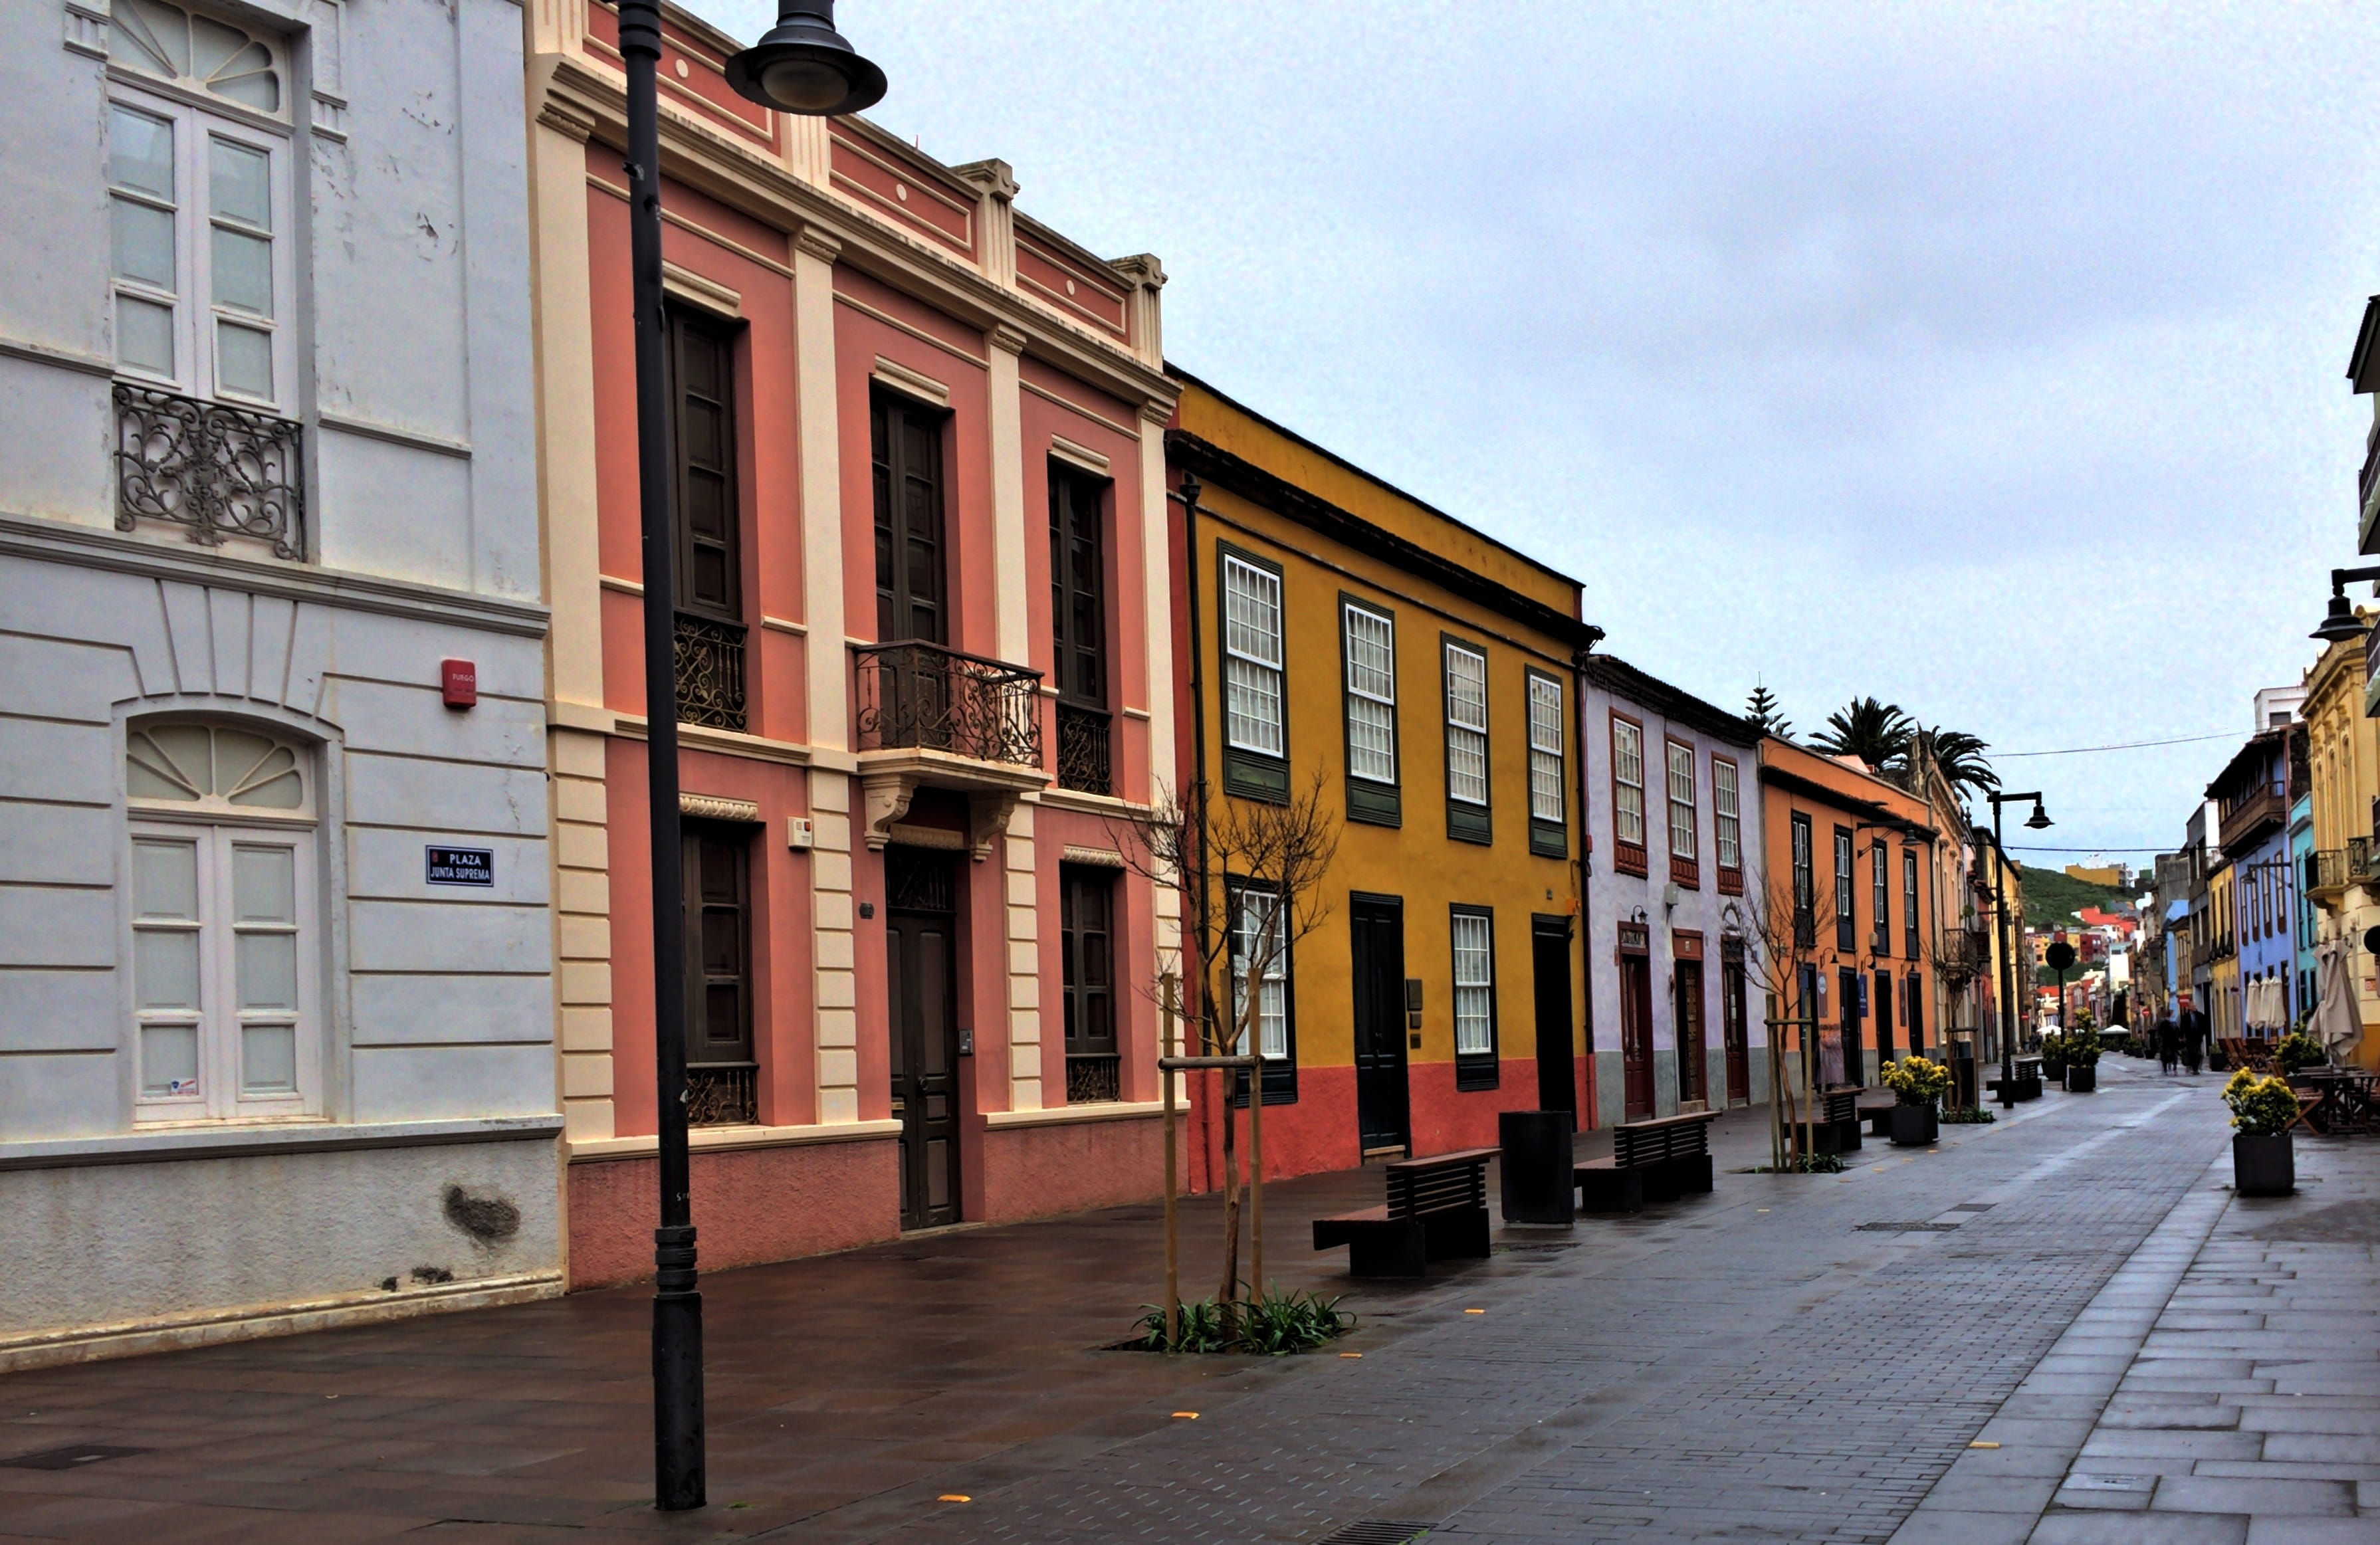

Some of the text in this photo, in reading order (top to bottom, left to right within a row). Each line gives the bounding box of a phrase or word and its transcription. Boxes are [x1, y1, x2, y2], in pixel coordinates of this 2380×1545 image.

[453, 673, 474, 682] FUEGO
[449, 854, 481, 866] PLAZA
[431, 867, 490, 880] JUNTA SUPREMA
